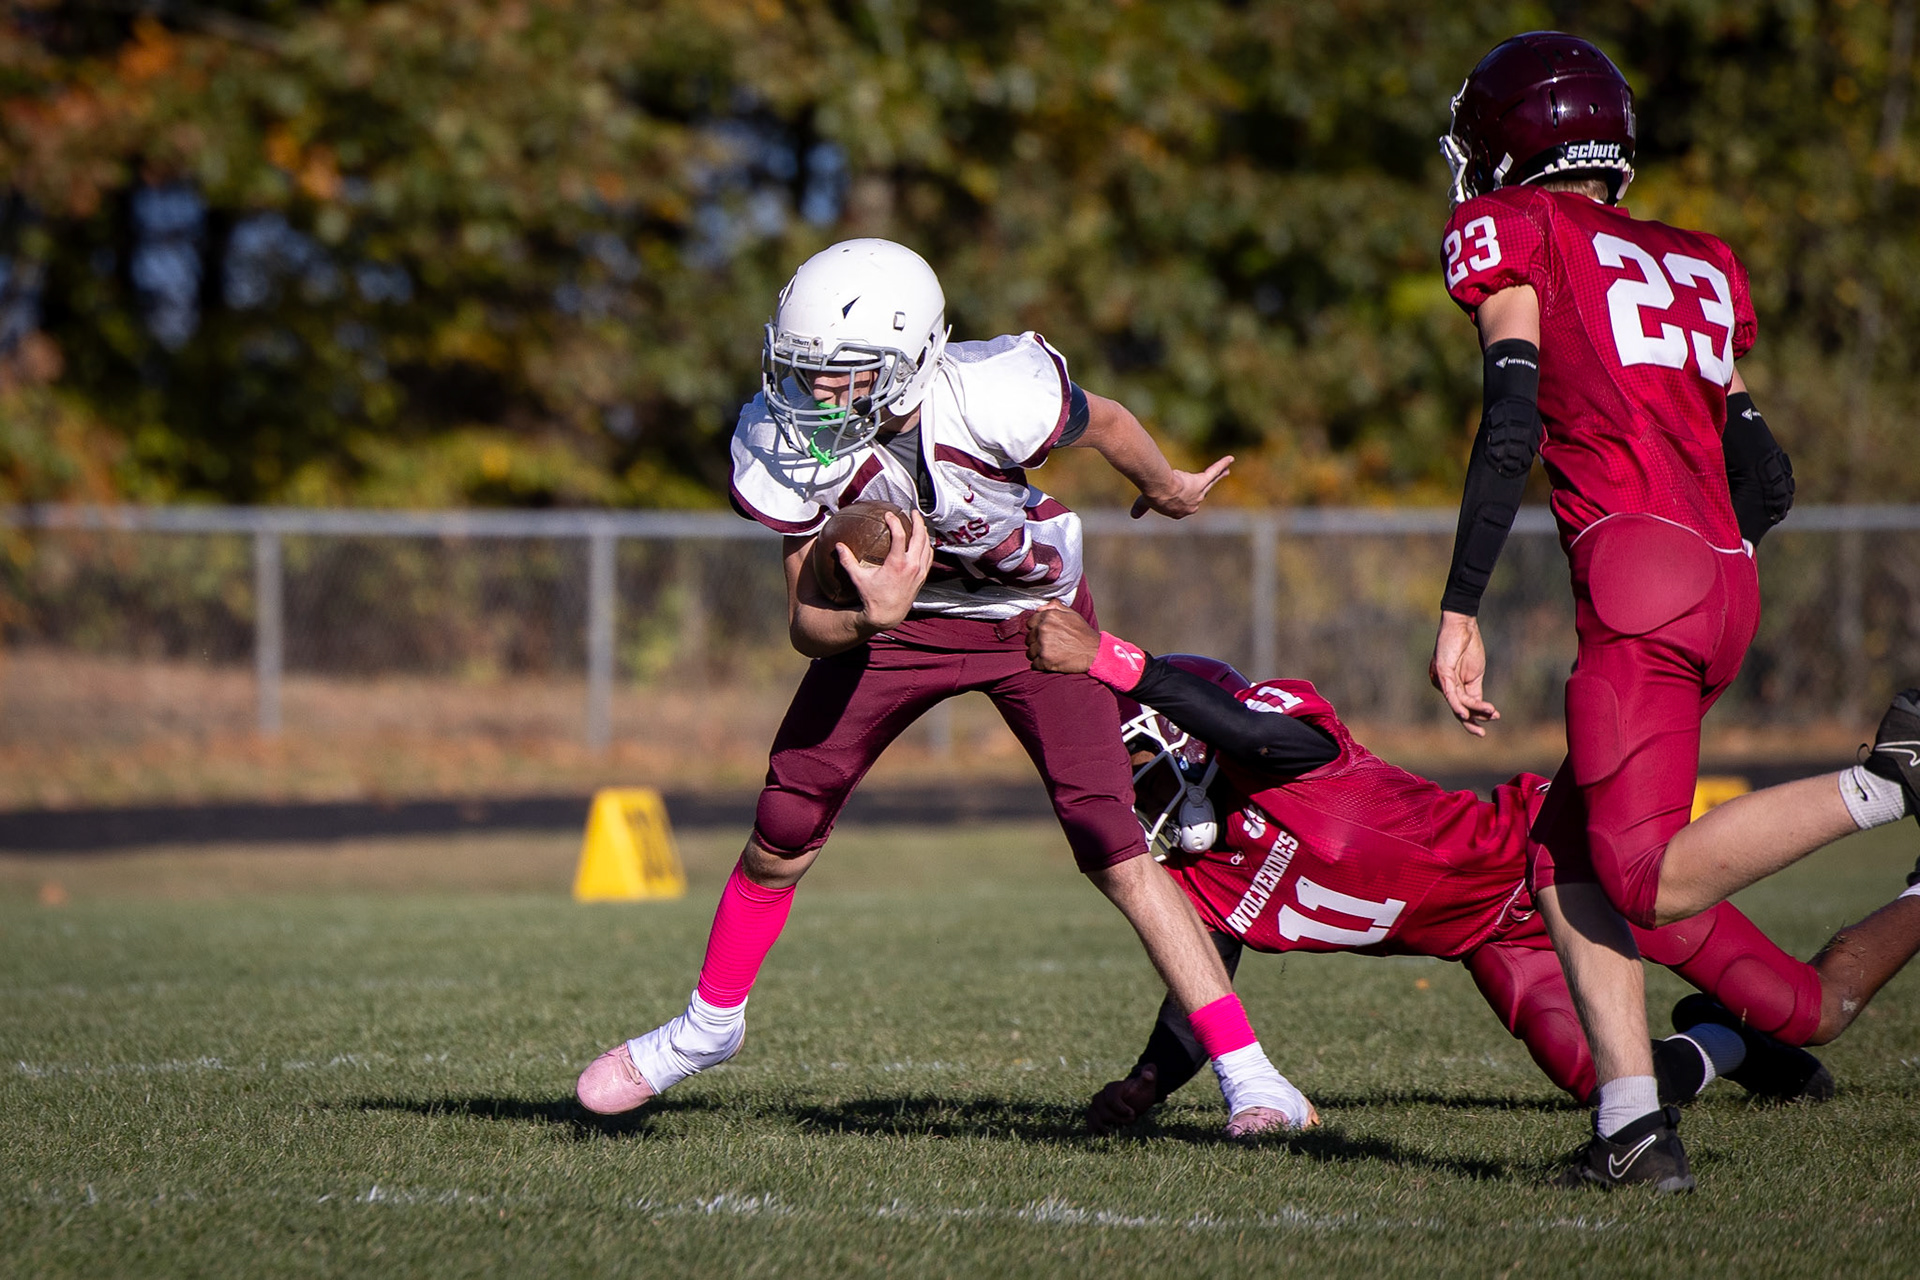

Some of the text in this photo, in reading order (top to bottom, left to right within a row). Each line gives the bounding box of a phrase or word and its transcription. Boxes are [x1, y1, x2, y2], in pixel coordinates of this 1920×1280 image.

[1567, 140, 1621, 160] schutt
[1444, 215, 1502, 290] 23
[1592, 231, 1735, 388] 23
[933, 517, 990, 549] AMS
[1226, 830, 1299, 935] WOLVERINES
[1278, 875, 1407, 947] 11
